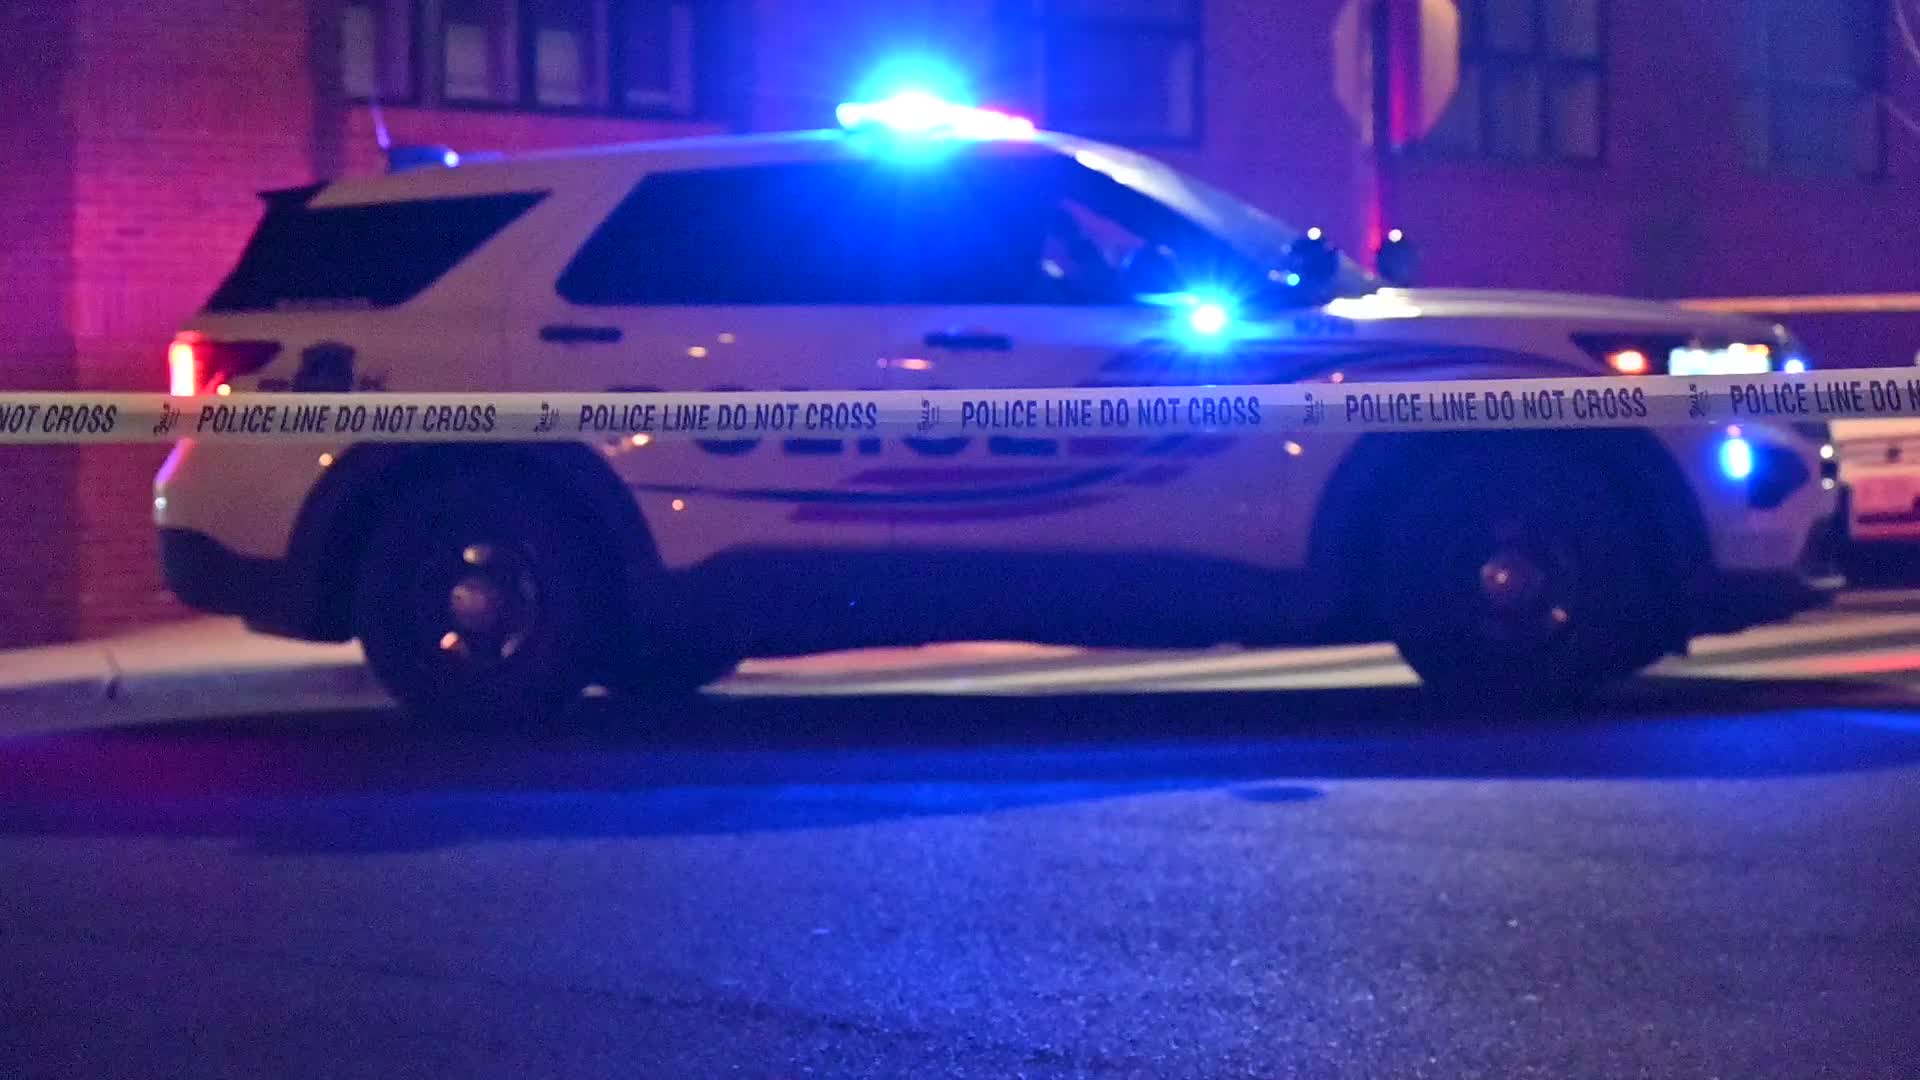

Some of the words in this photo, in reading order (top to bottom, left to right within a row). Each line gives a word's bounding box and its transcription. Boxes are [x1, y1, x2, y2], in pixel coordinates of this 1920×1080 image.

[961, 399, 1037, 428] POLICE
[1044, 399, 1092, 427] LINE
[1100, 398, 1129, 426] DO
[1137, 397, 1181, 425] NOT
[1188, 396, 1261, 425] CROSS
[1345, 393, 1423, 422] POLICE
[1429, 391, 1478, 421] LINE
[1484, 390, 1515, 421] DO
[1521, 389, 1565, 419] NOT
[1572, 387, 1647, 418] CROSS
[1730, 383, 1809, 415] POLICE
[1814, 380, 1865, 413] LINE
[1869, 379, 1901, 412] DO
[42, 404, 117, 433] CROSS
[197, 404, 277, 432] POLICE
[280, 404, 330, 432] LINE
[334, 404, 366, 432] DO
[372, 404, 419, 432] NOT
[422, 404, 496, 432] CROSS
[578, 403, 656, 432] POLICE
[662, 403, 710, 431] LINE
[716, 403, 747, 431] DO
[754, 403, 799, 430] NOT
[805, 401, 877, 430] CROSS
